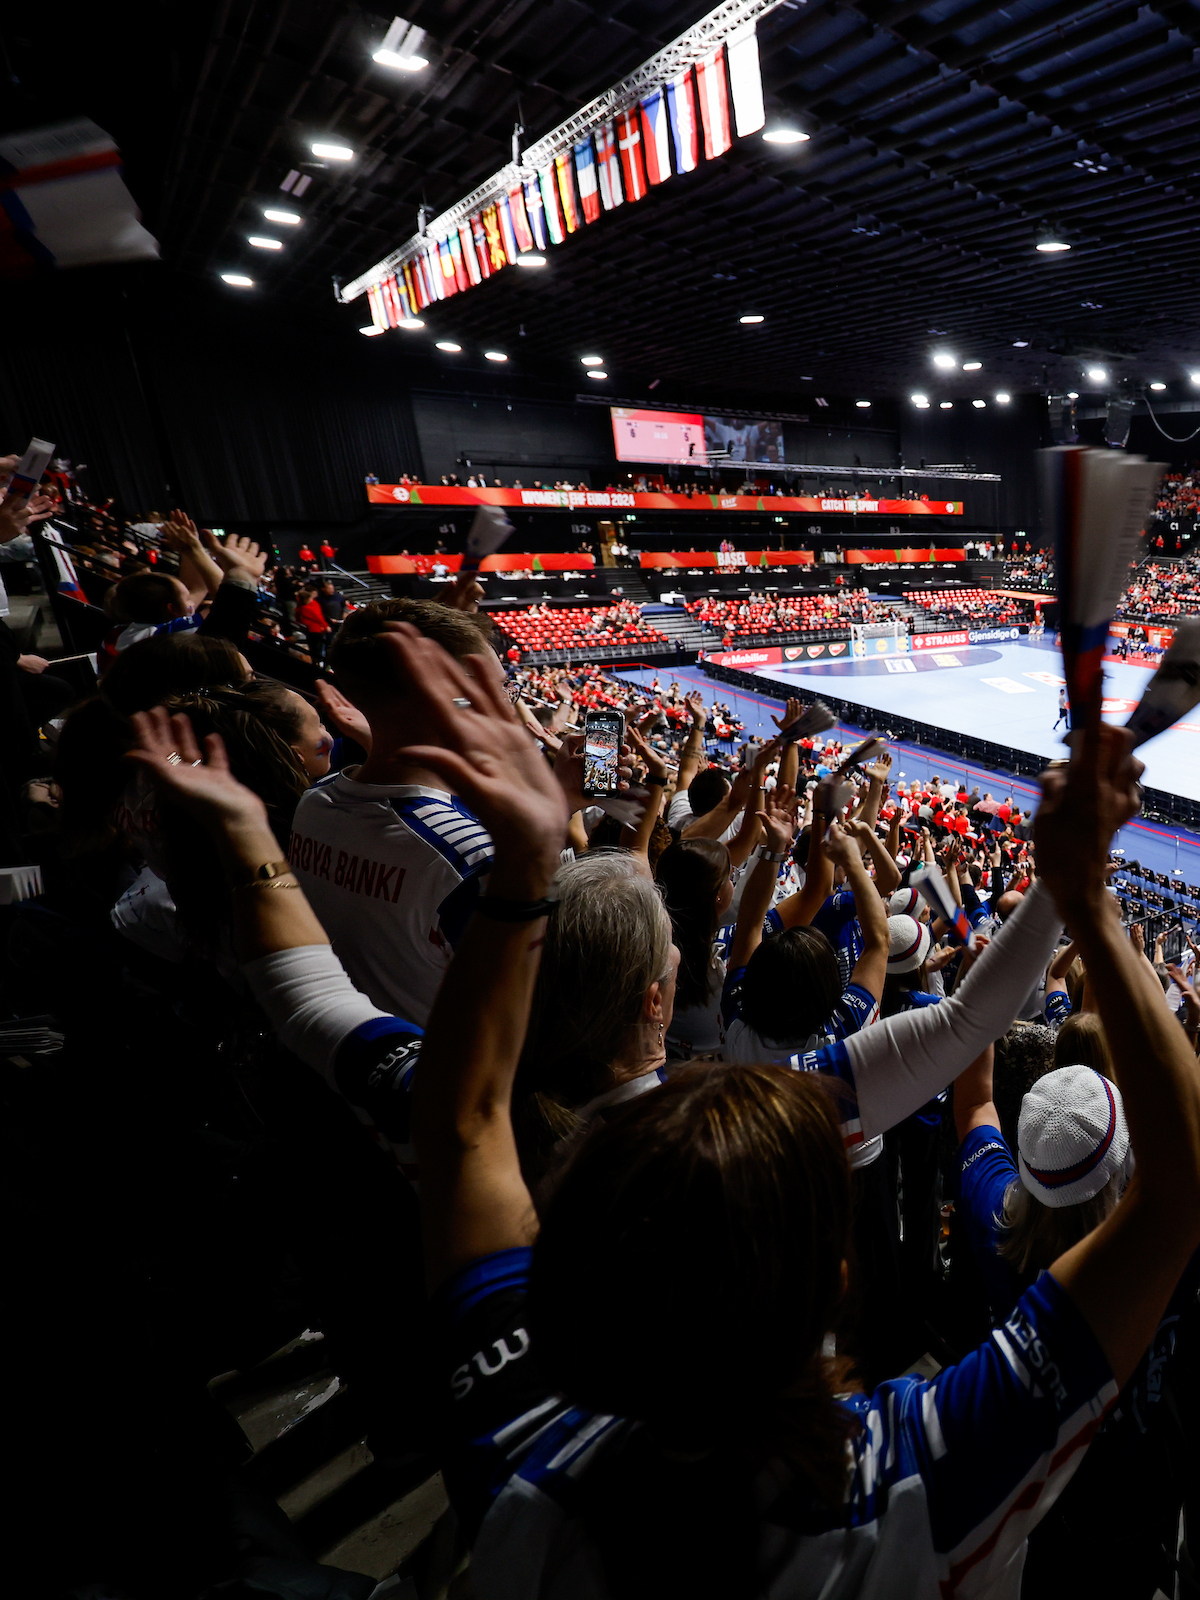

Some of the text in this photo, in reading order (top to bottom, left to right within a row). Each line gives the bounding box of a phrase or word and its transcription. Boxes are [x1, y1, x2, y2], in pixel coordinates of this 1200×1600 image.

[568, 492, 586, 505] EHF
[586, 493, 610, 506] EURO
[611, 493, 635, 506] 2024
[821, 499, 879, 512] CATCH THE SPIRIT
[1169, 521, 1179, 531] C1
[717, 551, 749, 566] BASEL
[925, 632, 967, 646] STRAUSS
[968, 629, 1010, 643] Gjensidige
[731, 652, 769, 665] Mobiliar
[288, 829, 407, 904] ROYA BANKI
